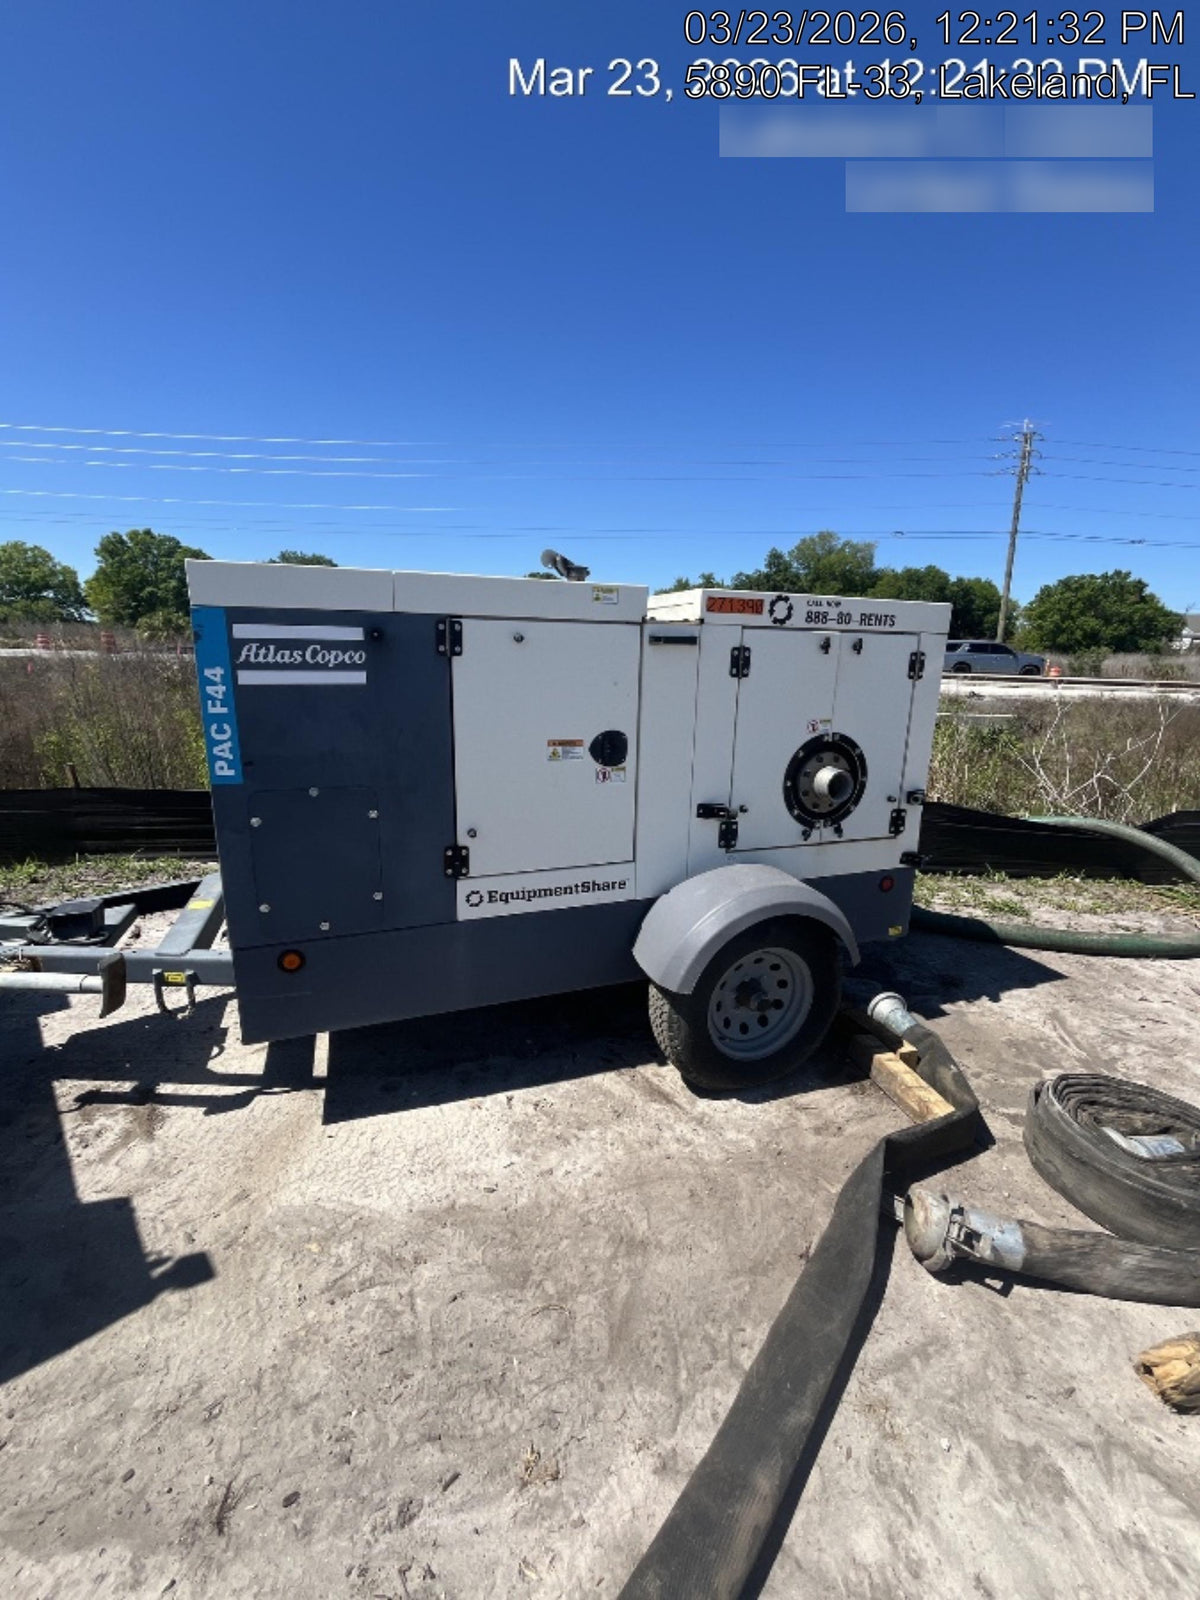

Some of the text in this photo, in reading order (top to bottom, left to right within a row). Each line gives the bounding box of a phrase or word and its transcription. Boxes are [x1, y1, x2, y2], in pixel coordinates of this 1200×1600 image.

[237, 643, 366, 668] Atlas Copco
[203, 666, 236, 776] PAC F44
[487, 879, 627, 904] EquipmentShare
